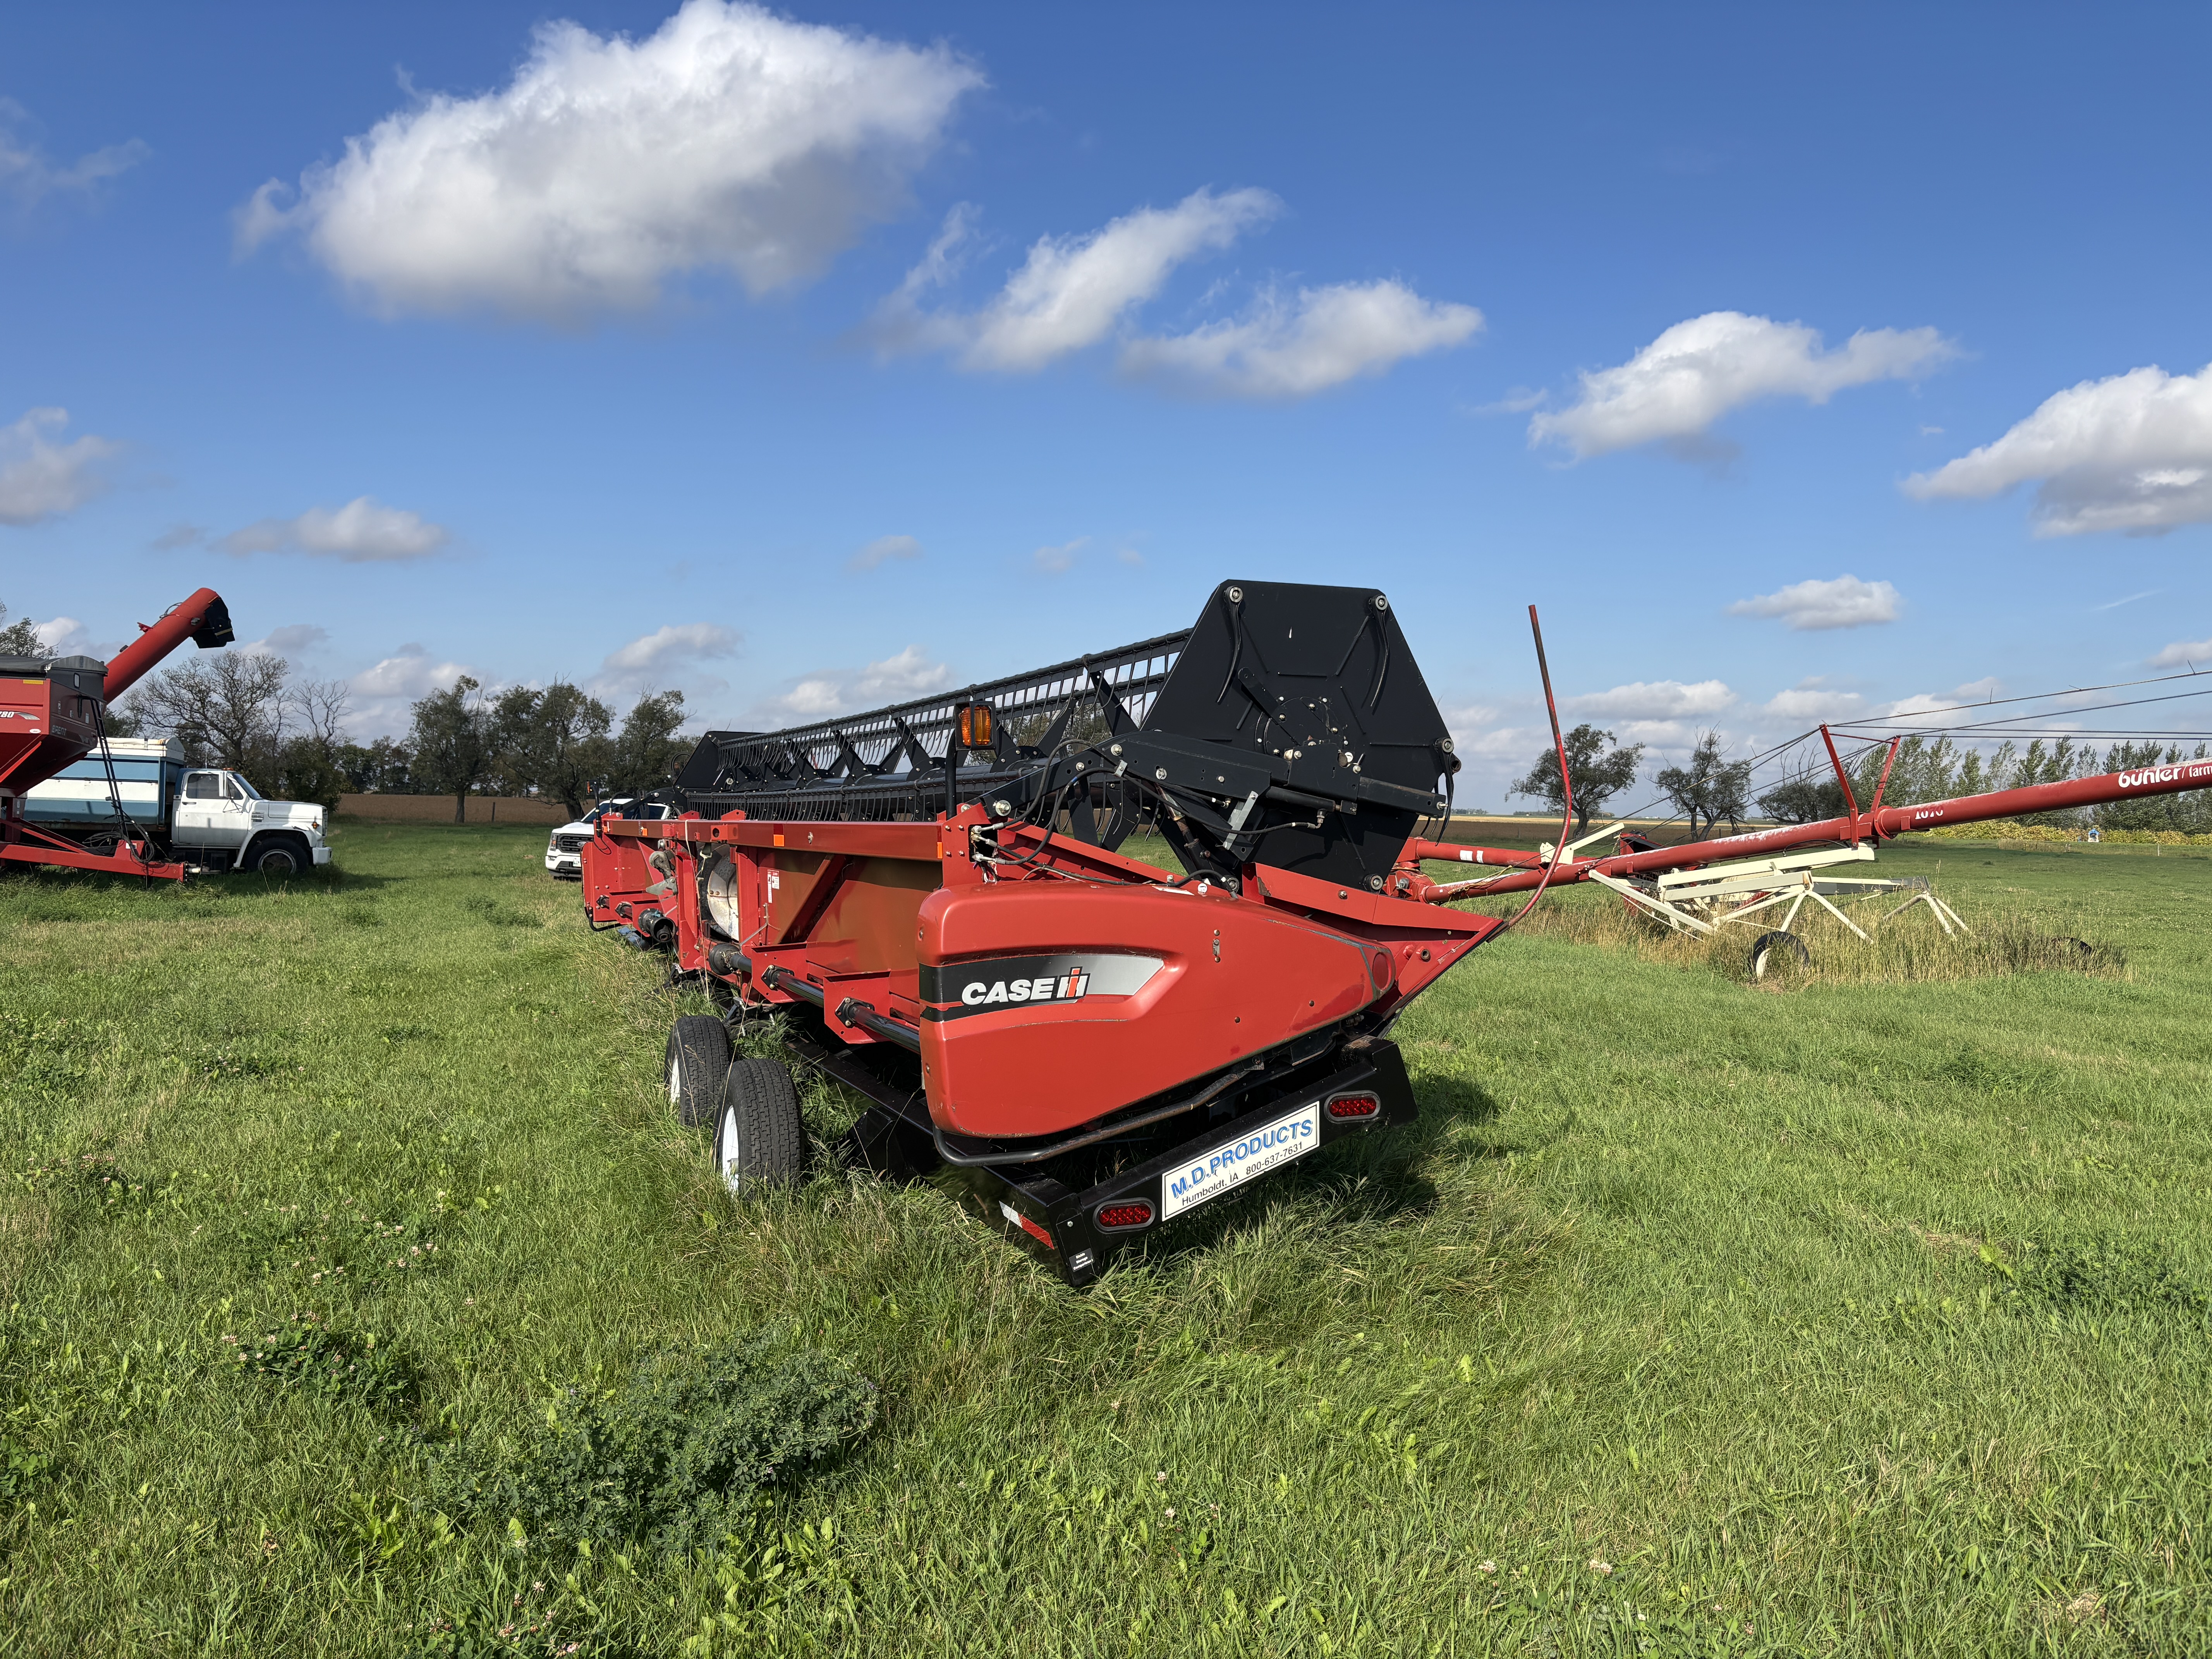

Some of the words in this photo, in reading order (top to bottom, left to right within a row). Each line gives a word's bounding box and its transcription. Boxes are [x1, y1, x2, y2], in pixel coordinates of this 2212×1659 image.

[52, 725, 67, 736] BRENT
[962, 977, 1055, 1005] CASE
[1182, 1178, 1227, 1206] Humboldt,
[1230, 1175, 1239, 1183] IA
[1246, 1141, 1302, 1175] 800-637-7631
